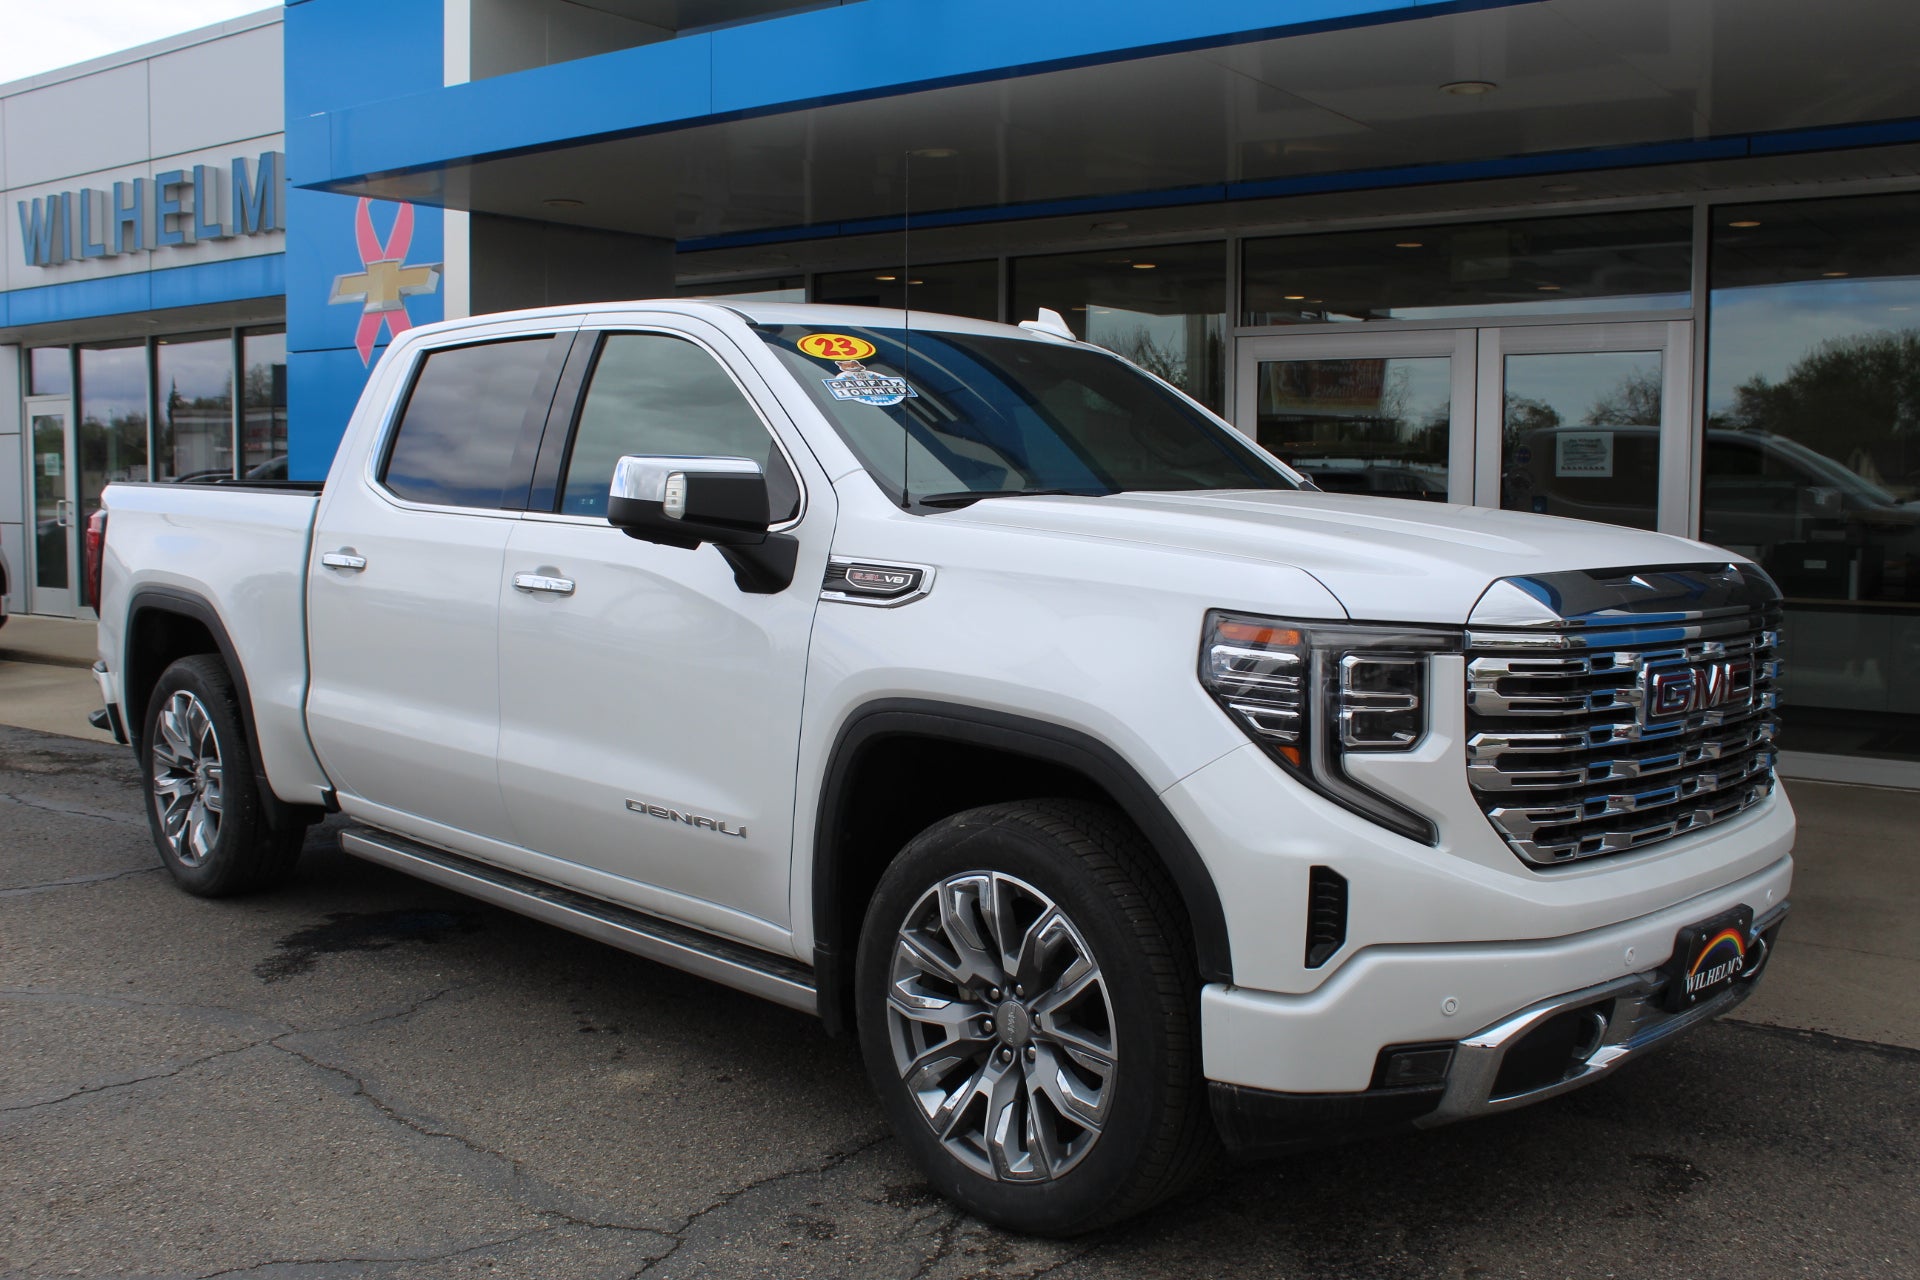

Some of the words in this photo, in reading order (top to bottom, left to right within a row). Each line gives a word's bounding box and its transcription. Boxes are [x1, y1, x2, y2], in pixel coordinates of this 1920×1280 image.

[18, 151, 284, 267] WILHELM
[814, 337, 858, 357] 23
[831, 379, 905, 389] CARFAX
[850, 388, 910, 397] OWNER
[1652, 662, 1752, 717] GMC
[625, 798, 747, 839] DENALI
[1685, 954, 1744, 994] WILHELM'S
